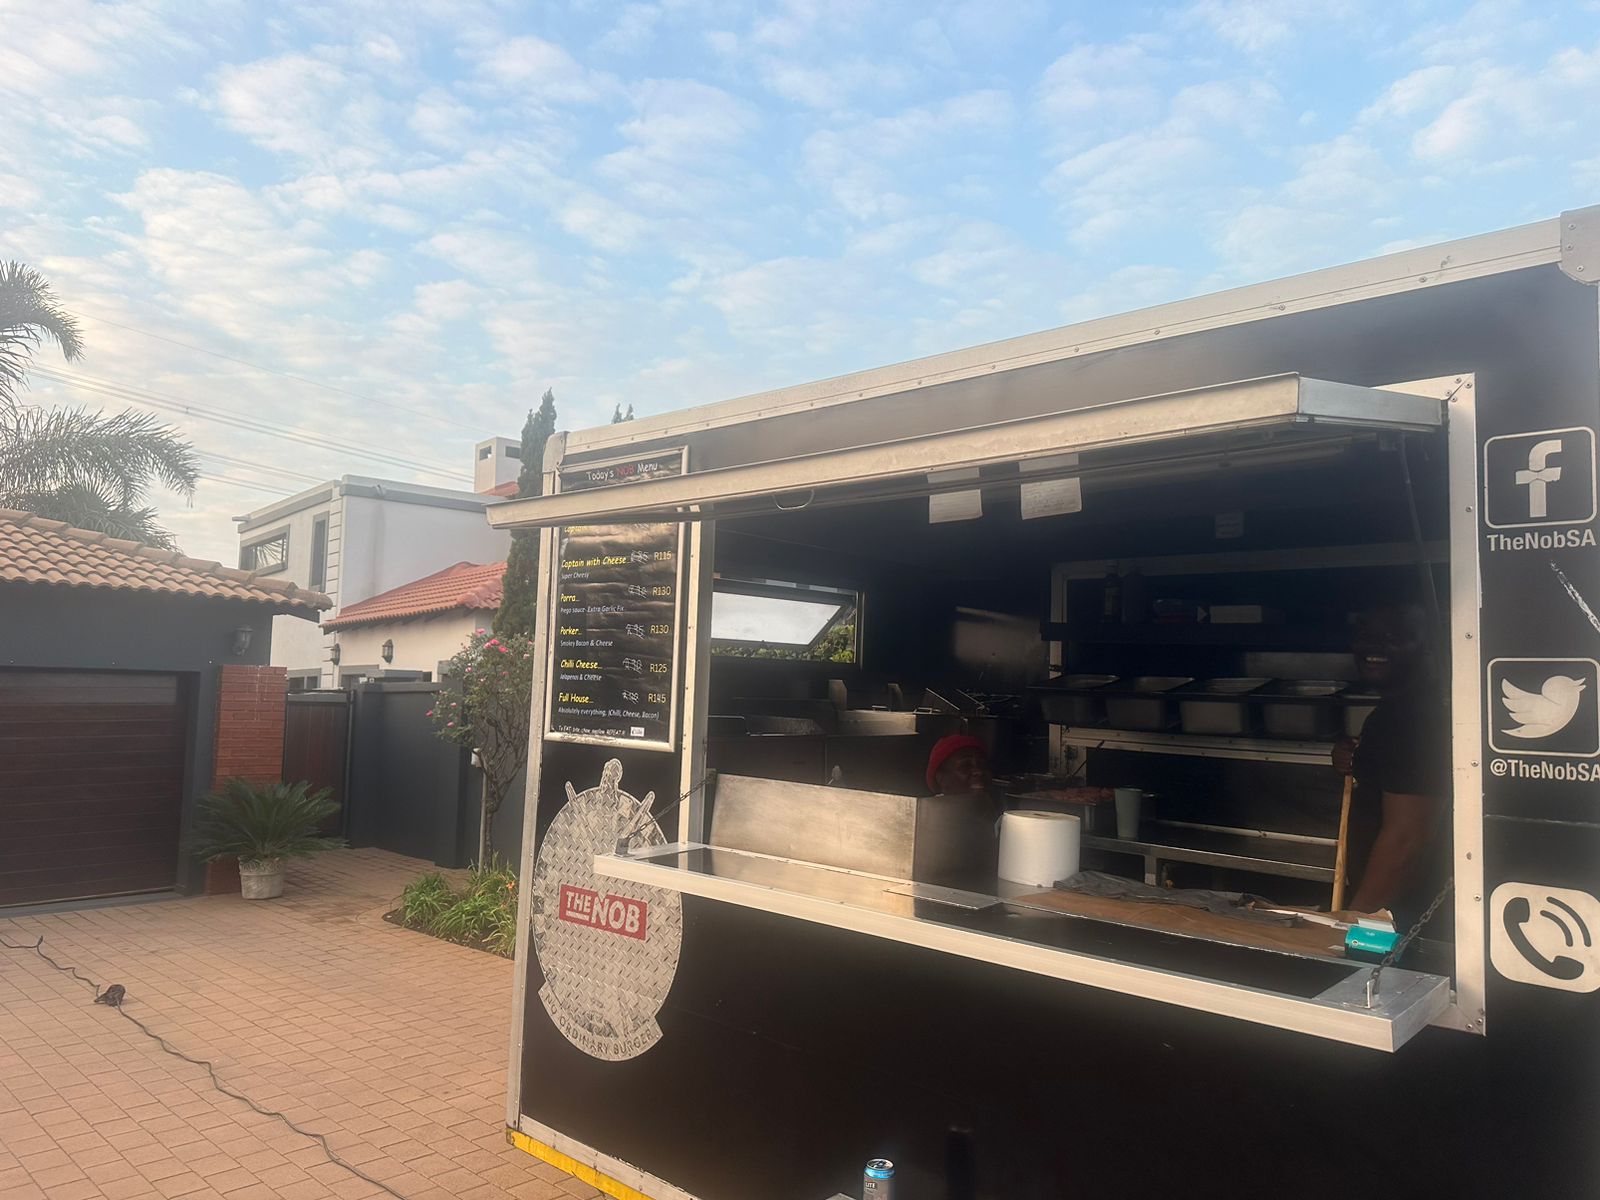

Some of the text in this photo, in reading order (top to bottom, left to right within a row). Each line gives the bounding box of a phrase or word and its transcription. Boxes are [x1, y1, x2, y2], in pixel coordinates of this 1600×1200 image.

[637, 462, 658, 473] Menu
[1487, 529, 1597, 551] TheNobSA
[587, 556, 601, 566] with
[652, 586, 671, 596] R130
[650, 625, 669, 634] R130
[650, 663, 668, 673] R125
[1490, 759, 1600, 782] @TheNobSA
[566, 890, 640, 934] THE NOB
[544, 993, 654, 1056] NO ORDINARY BURGER
